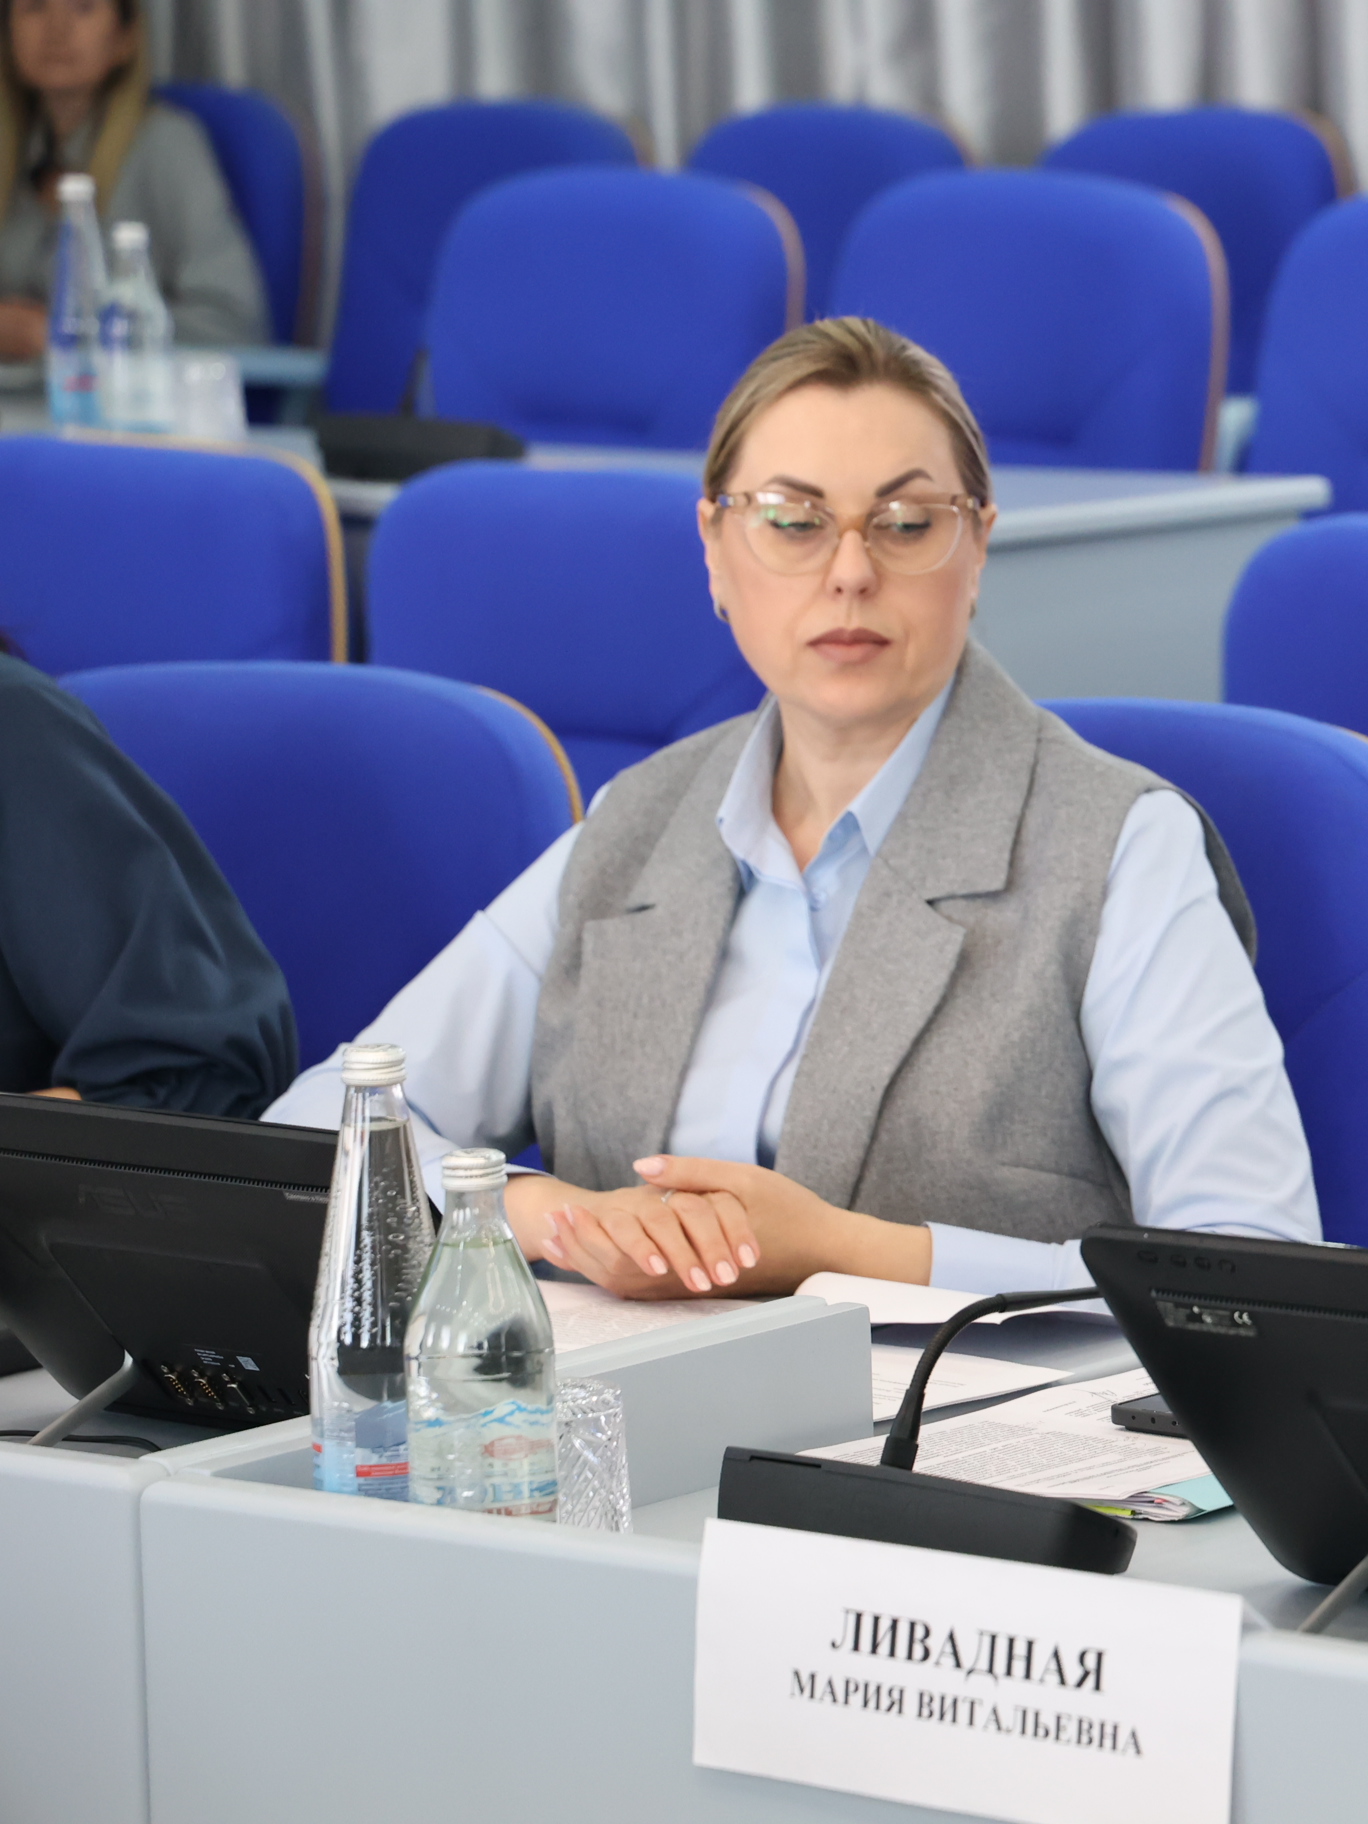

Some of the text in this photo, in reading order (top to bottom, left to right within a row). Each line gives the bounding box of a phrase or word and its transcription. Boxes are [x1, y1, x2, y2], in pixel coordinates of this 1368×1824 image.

[831, 1608, 1107, 1693] ЛИВАДНАЯ
[790, 1669, 1145, 1757] МАРИЯ ВИТАЛЬЕВНА
